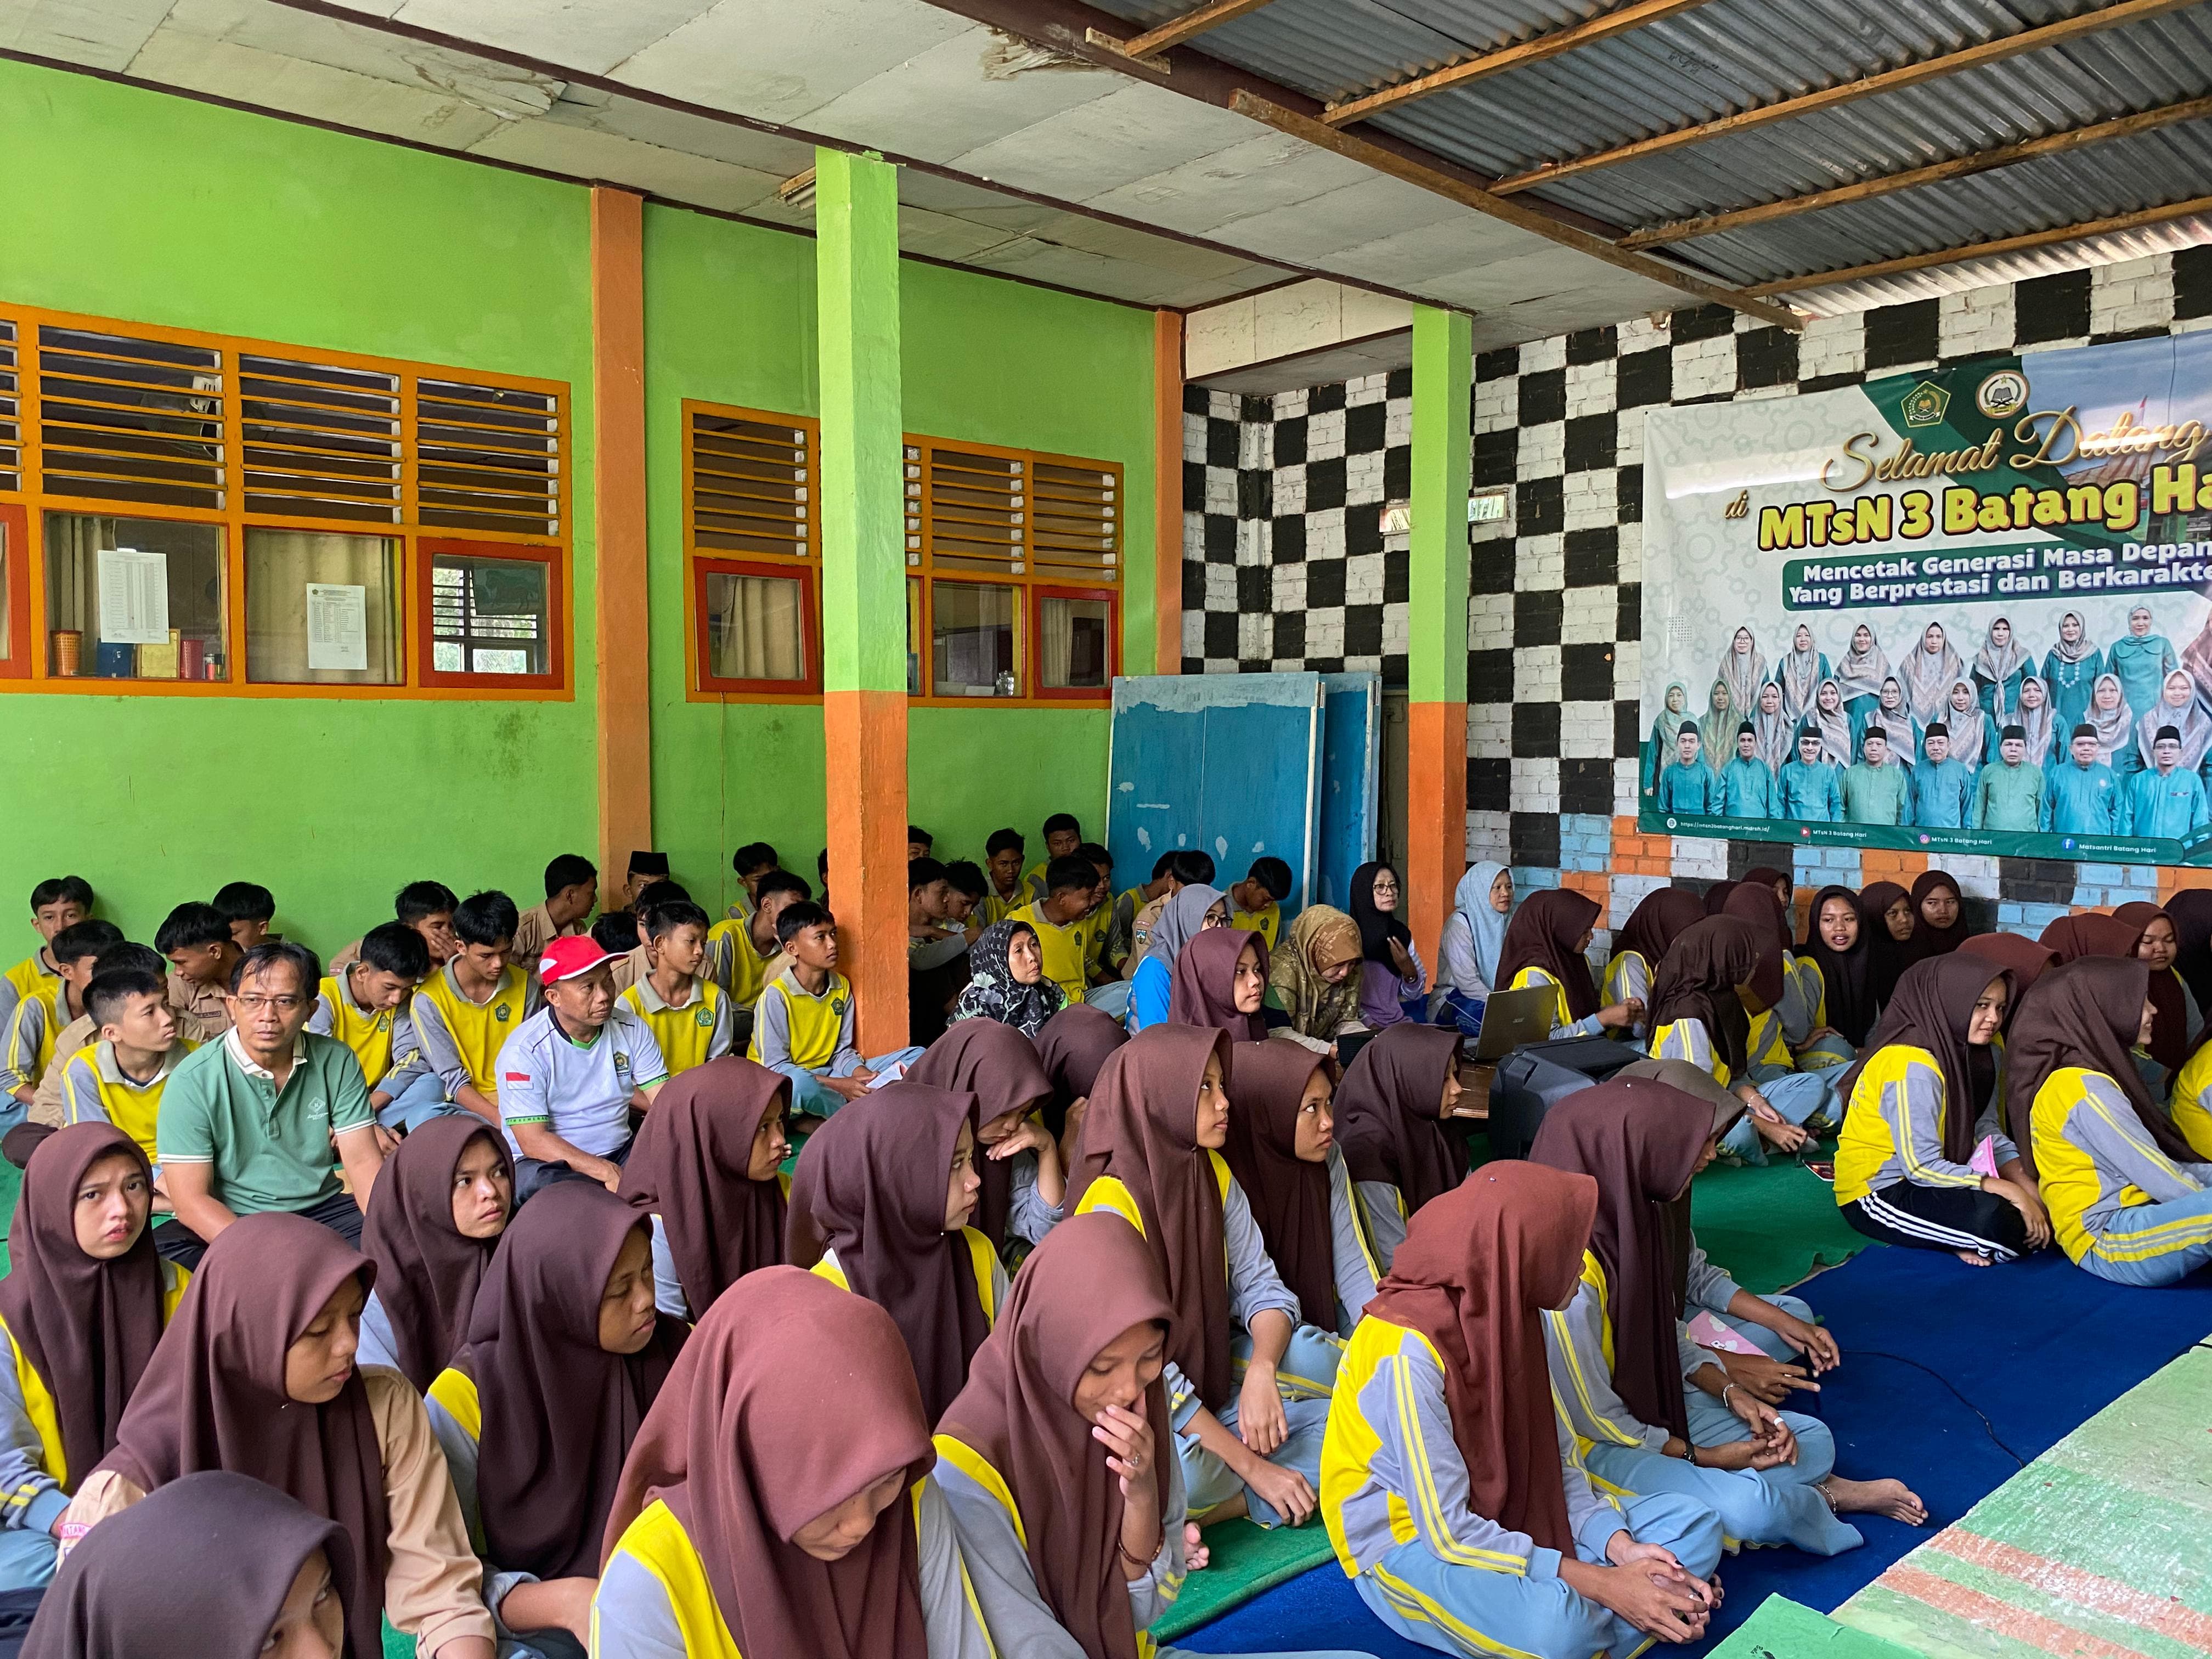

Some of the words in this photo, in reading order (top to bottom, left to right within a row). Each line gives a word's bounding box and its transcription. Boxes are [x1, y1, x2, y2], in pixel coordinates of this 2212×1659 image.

[1820, 428, 2005, 492] Selamat
[2009, 405, 2211, 463] Datang
[1724, 489, 1750, 519] di
[1758, 494, 1892, 550] MTsN
[1900, 491, 1933, 538] 3
[1944, 481, 2138, 531] Batang
[1803, 557, 1917, 583] Mencetak
[1922, 548, 2035, 575] Generasi
[2044, 547, 2113, 567] Masa
[2122, 540, 2212, 565] Depan
[1789, 586, 1843, 606] Yang
[1850, 573, 1990, 603] Berprestasi
[1997, 572, 2050, 593] dan
[1955, 837, 1978, 845] Batang
[2079, 843, 2112, 851] Matsantri
[2113, 845, 2139, 854] Batang
